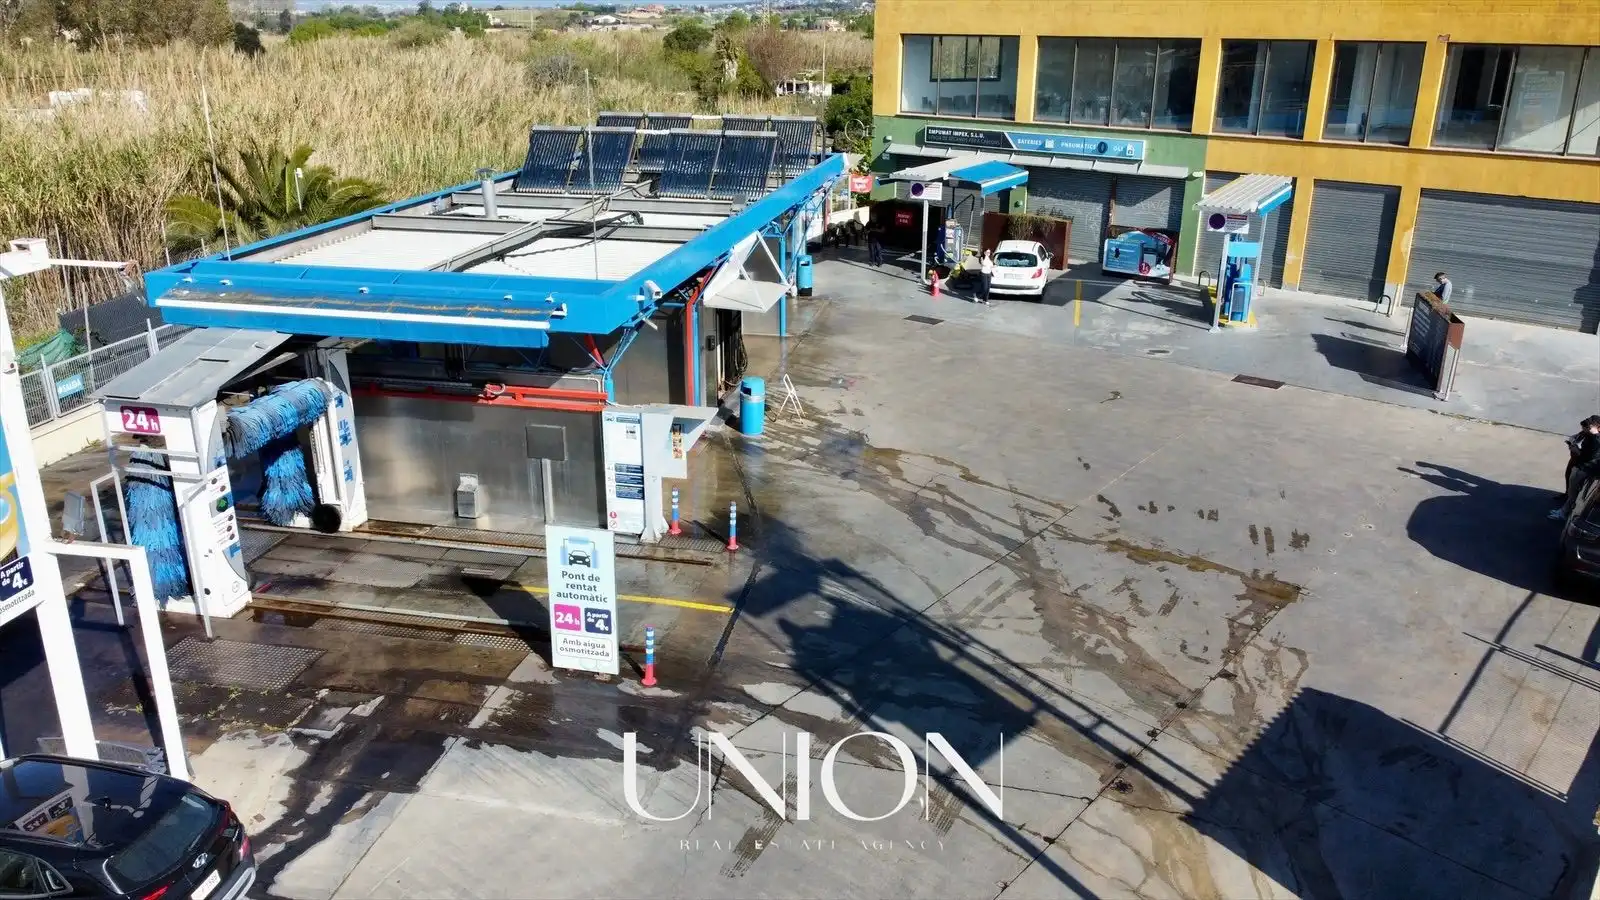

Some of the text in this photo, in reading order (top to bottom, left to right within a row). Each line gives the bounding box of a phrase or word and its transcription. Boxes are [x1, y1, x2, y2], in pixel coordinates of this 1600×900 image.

[1017, 138, 1041, 146] BATERIES
[1061, 141, 1096, 150] PNEUMATICS
[0, 561, 24, 579] A partir
[562, 570, 601, 582] Pont de
[1, 577, 11, 587] de
[565, 582, 597, 592] rentat
[556, 591, 608, 603] automàtic
[562, 637, 606, 650] Amb aigua
[559, 645, 610, 657] osmotitzada
